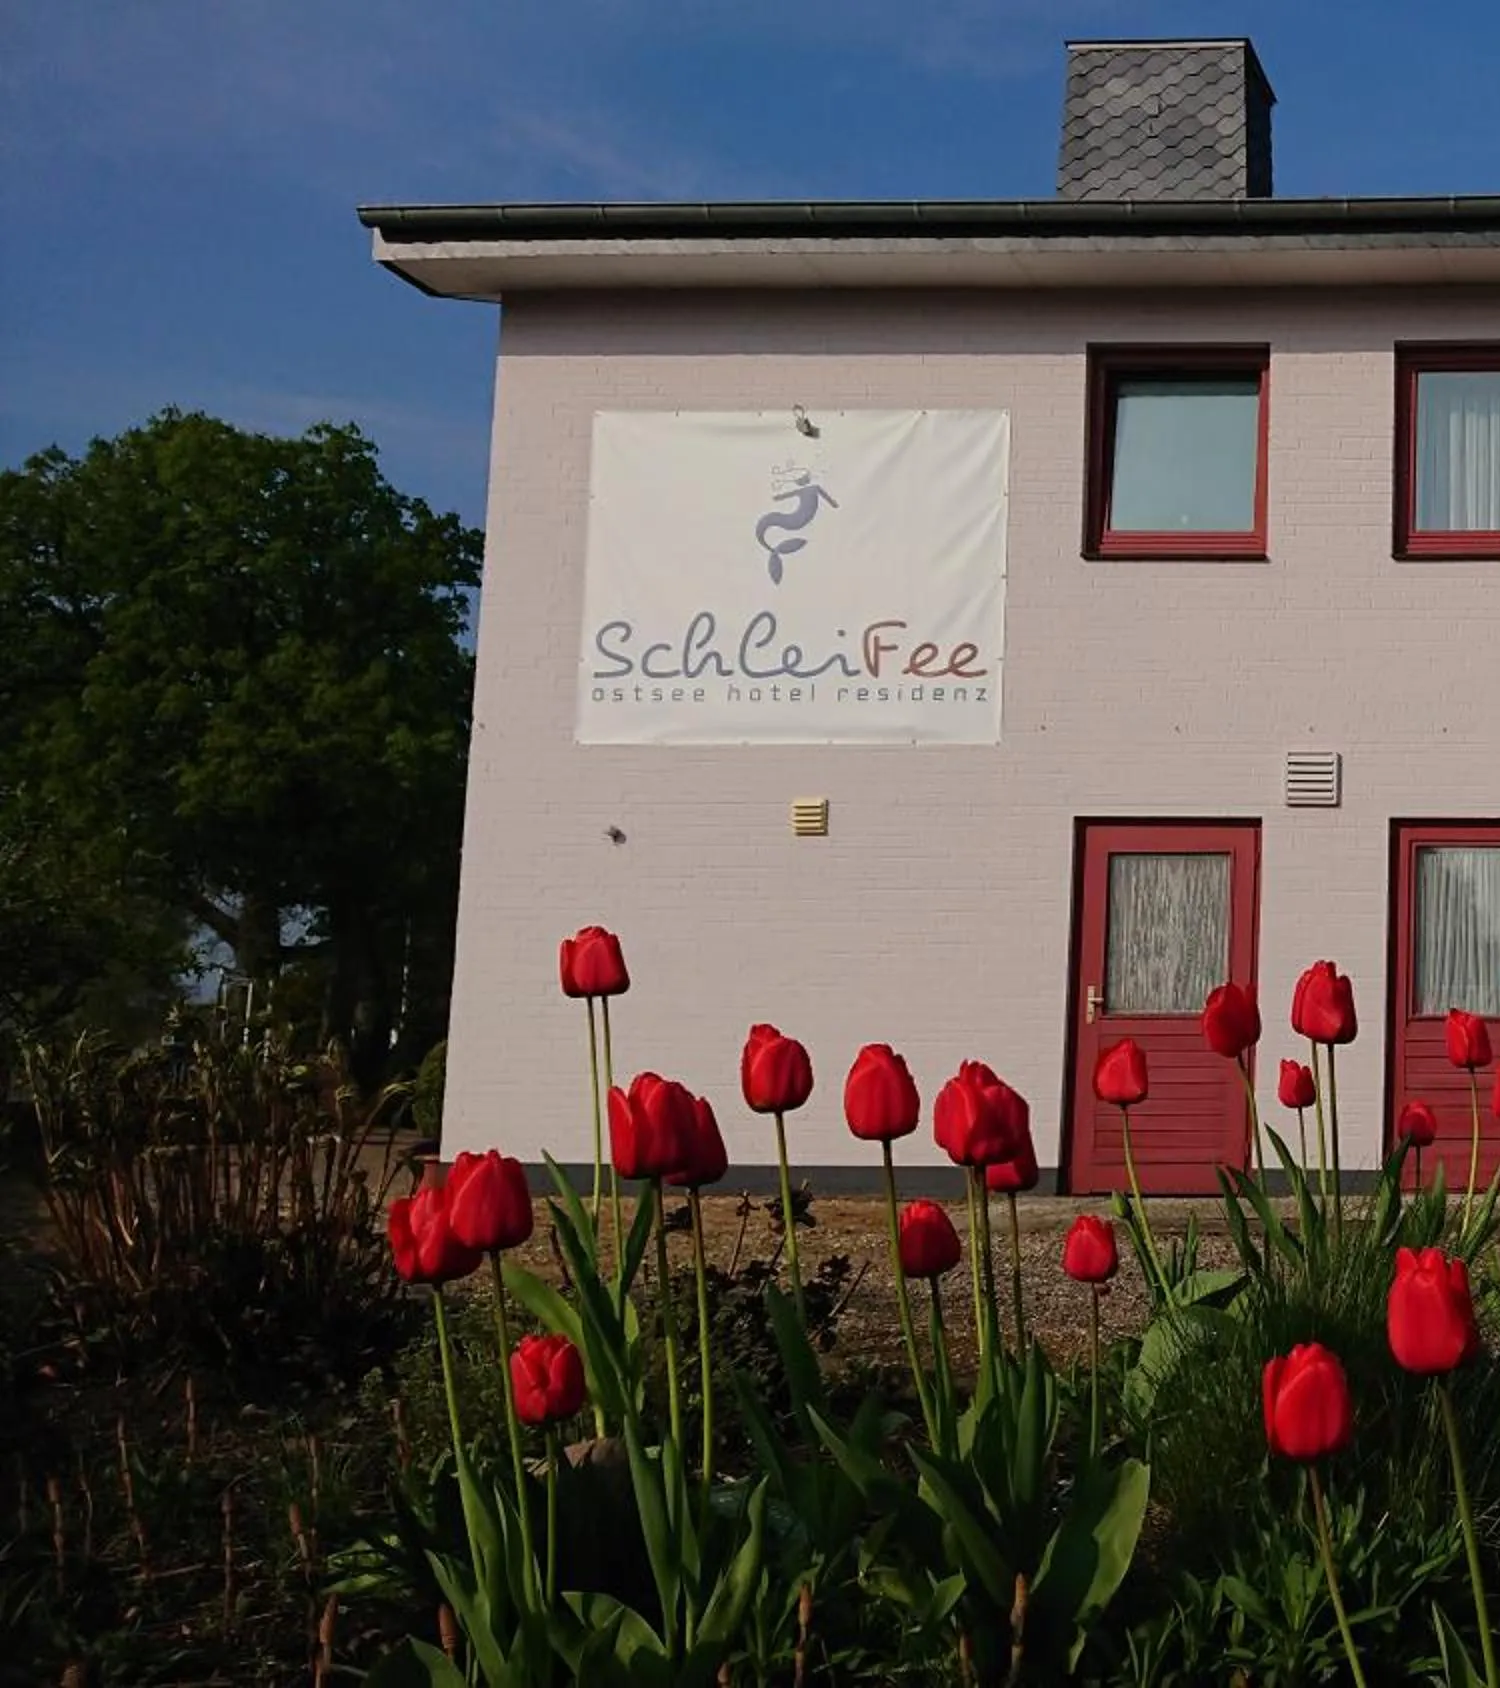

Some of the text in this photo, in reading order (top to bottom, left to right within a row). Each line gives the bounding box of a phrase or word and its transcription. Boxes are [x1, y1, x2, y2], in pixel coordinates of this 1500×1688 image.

[592, 610, 988, 679] SchleiFee
[591, 683, 988, 702] ostsee hotel residenz
